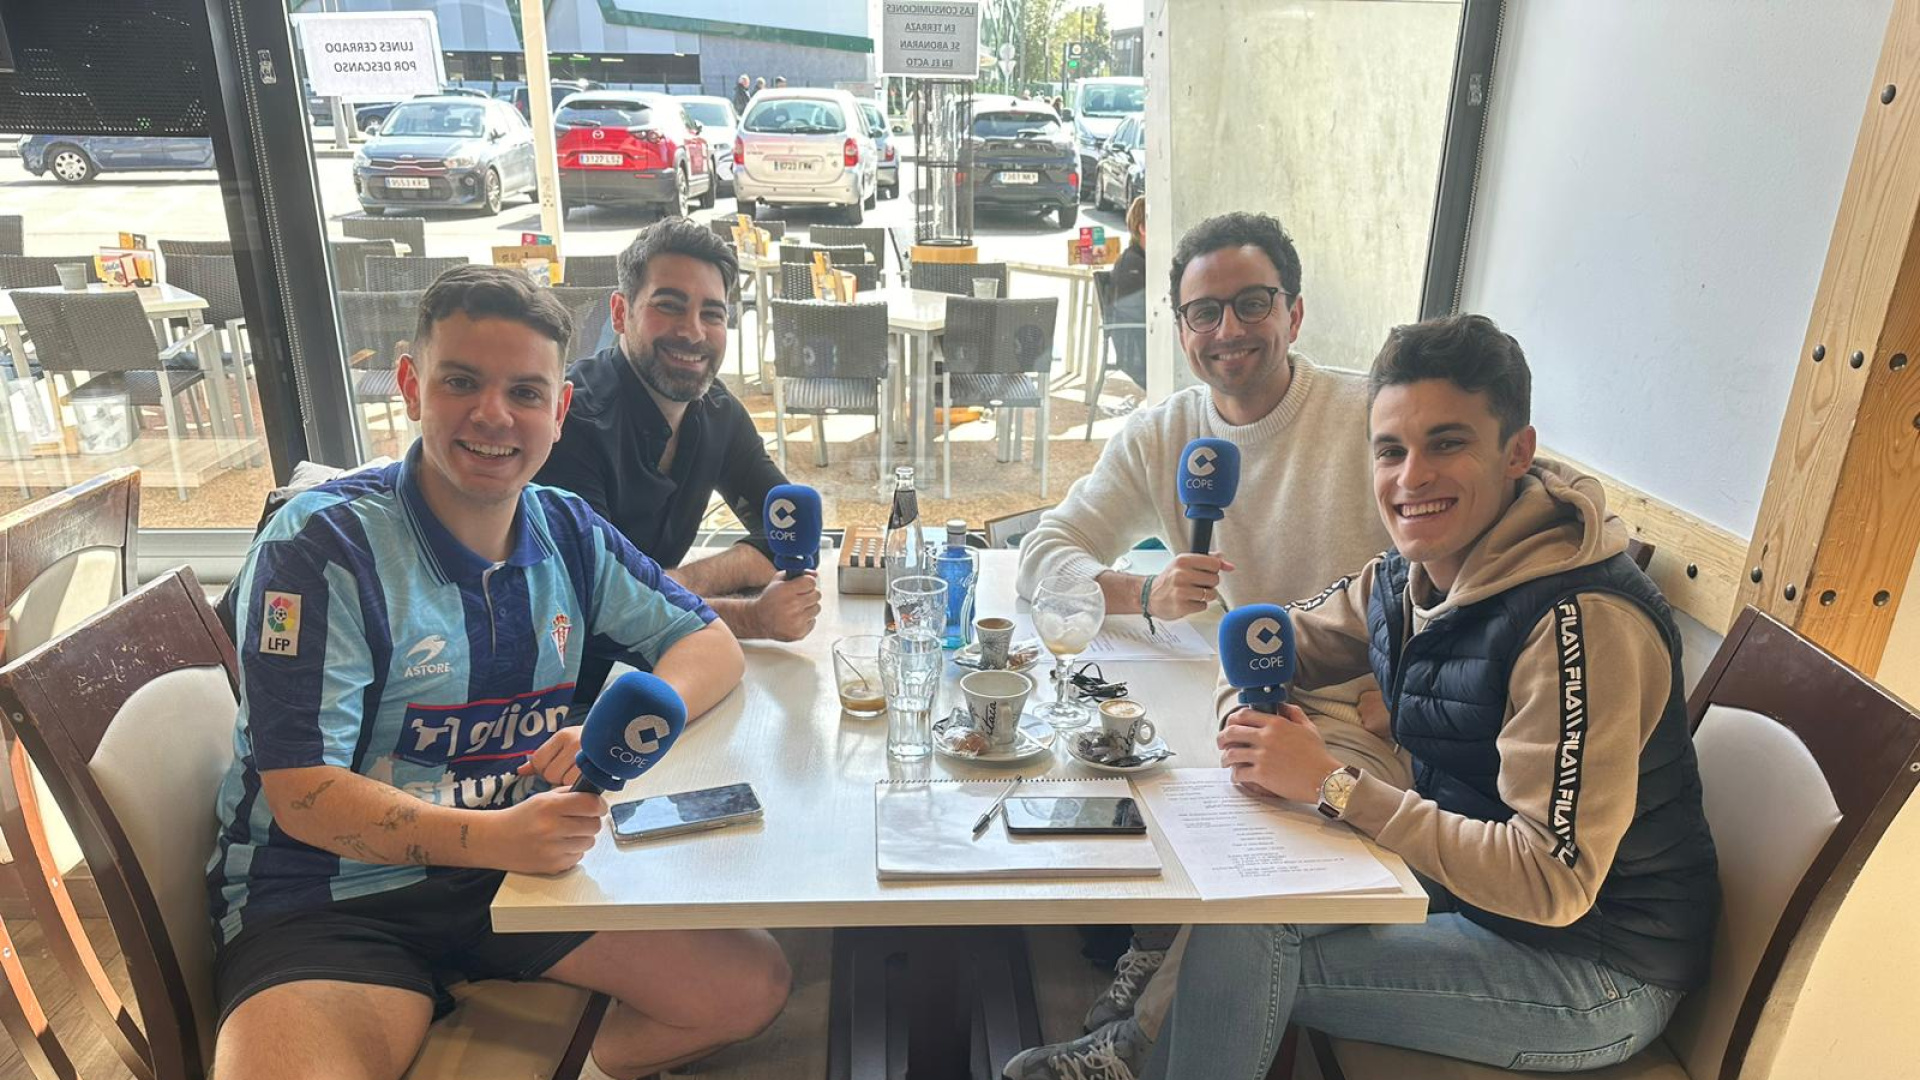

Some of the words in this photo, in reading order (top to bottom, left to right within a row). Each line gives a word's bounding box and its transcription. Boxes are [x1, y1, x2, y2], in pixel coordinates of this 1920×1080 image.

[1186, 478, 1214, 490] COPE
[769, 529, 797, 541] COPE
[1559, 603, 1578, 647] FILA
[268, 637, 290, 651] LFP
[404, 662, 450, 678] ASTORE
[1249, 656, 1285, 671] COPE
[1564, 666, 1583, 711] FILA
[466, 698, 570, 753] gijón
[610, 746, 649, 769] COPE
[1553, 789, 1575, 828] FILA
